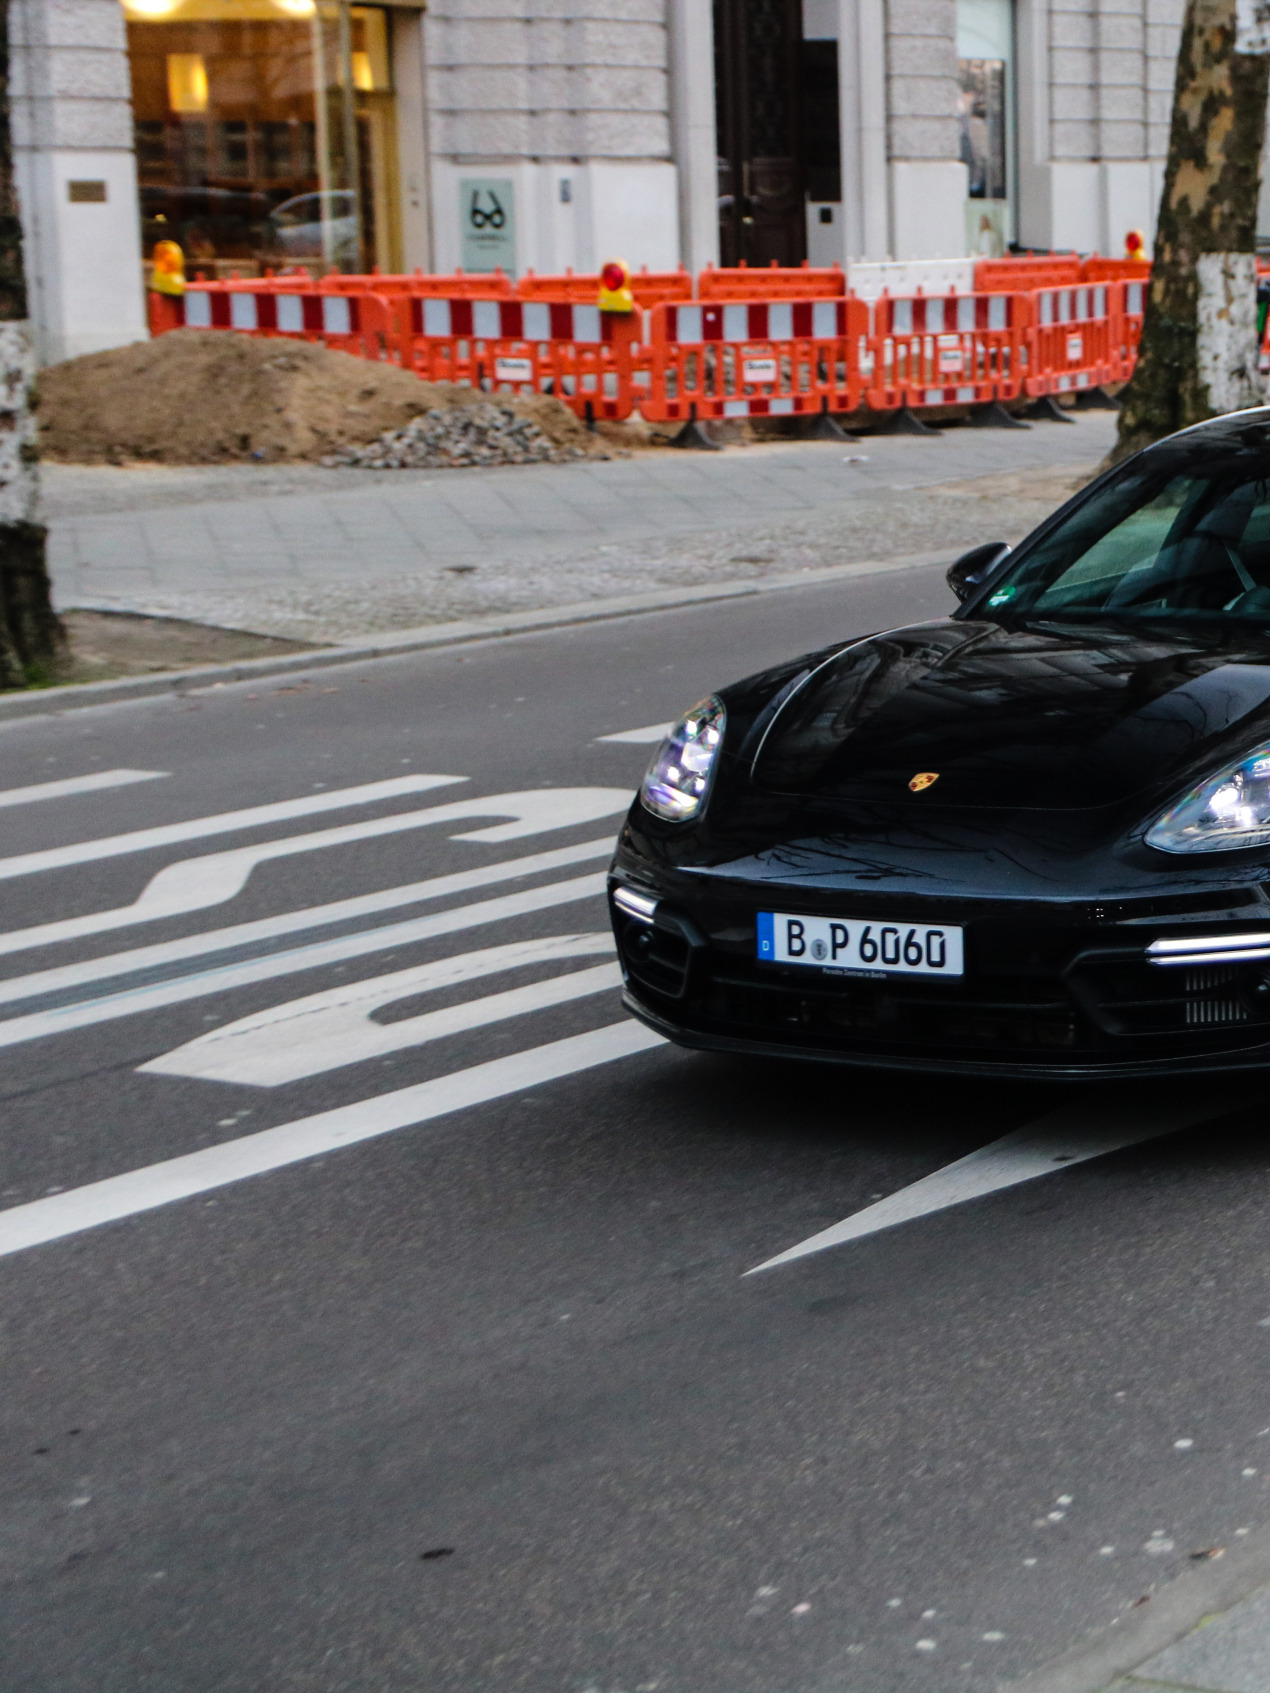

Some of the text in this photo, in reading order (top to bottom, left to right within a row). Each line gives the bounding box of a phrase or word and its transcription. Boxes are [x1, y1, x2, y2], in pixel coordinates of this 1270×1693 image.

[786, 919, 806, 957] B
[829, 923, 849, 961] P
[859, 925, 947, 968] 6060
